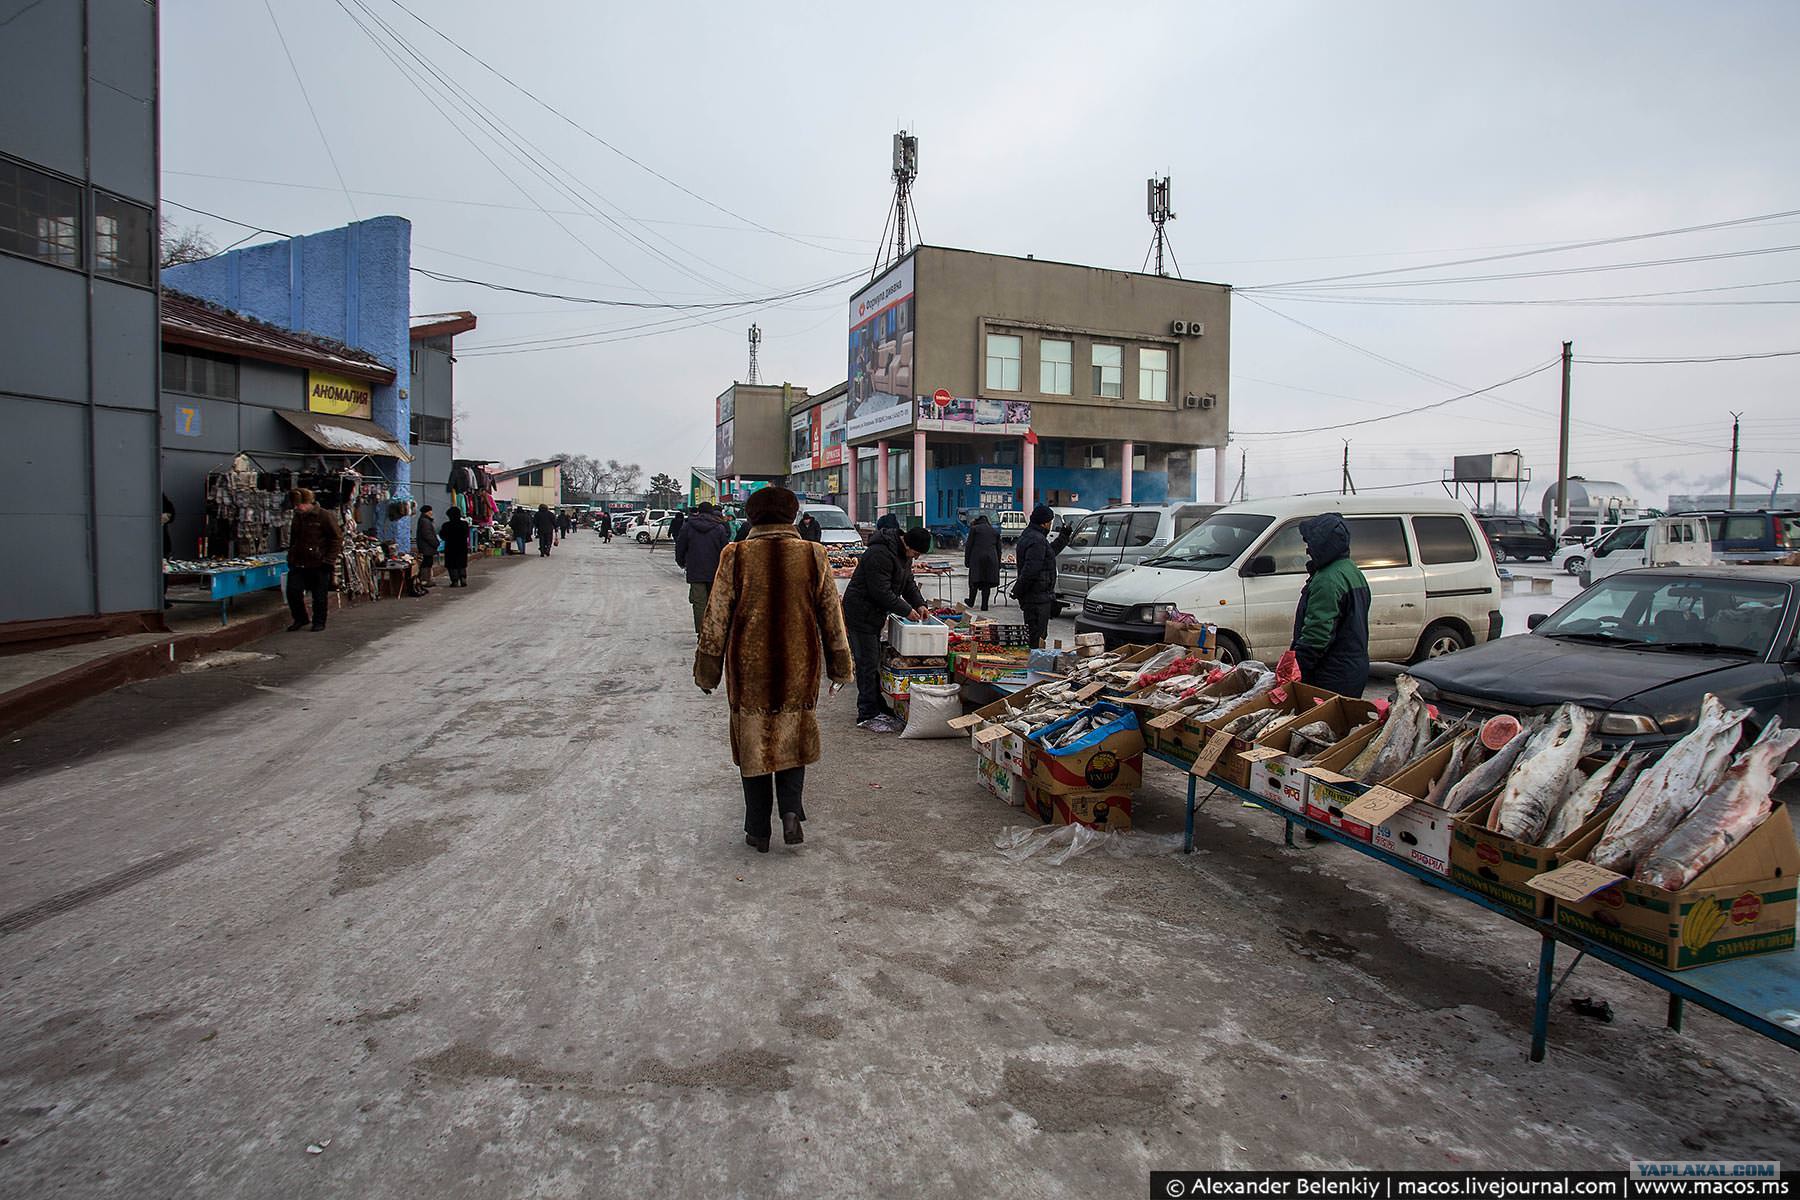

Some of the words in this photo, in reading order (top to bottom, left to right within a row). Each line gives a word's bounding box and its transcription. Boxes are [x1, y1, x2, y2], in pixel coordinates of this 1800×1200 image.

[312, 383, 369, 406] АНОМАЛИЯ
[181, 408, 195, 433] 7
[1061, 563, 1106, 576] PRADO
[1283, 786, 1300, 802] Dole
[1608, 932, 1665, 960] PREMIUM
